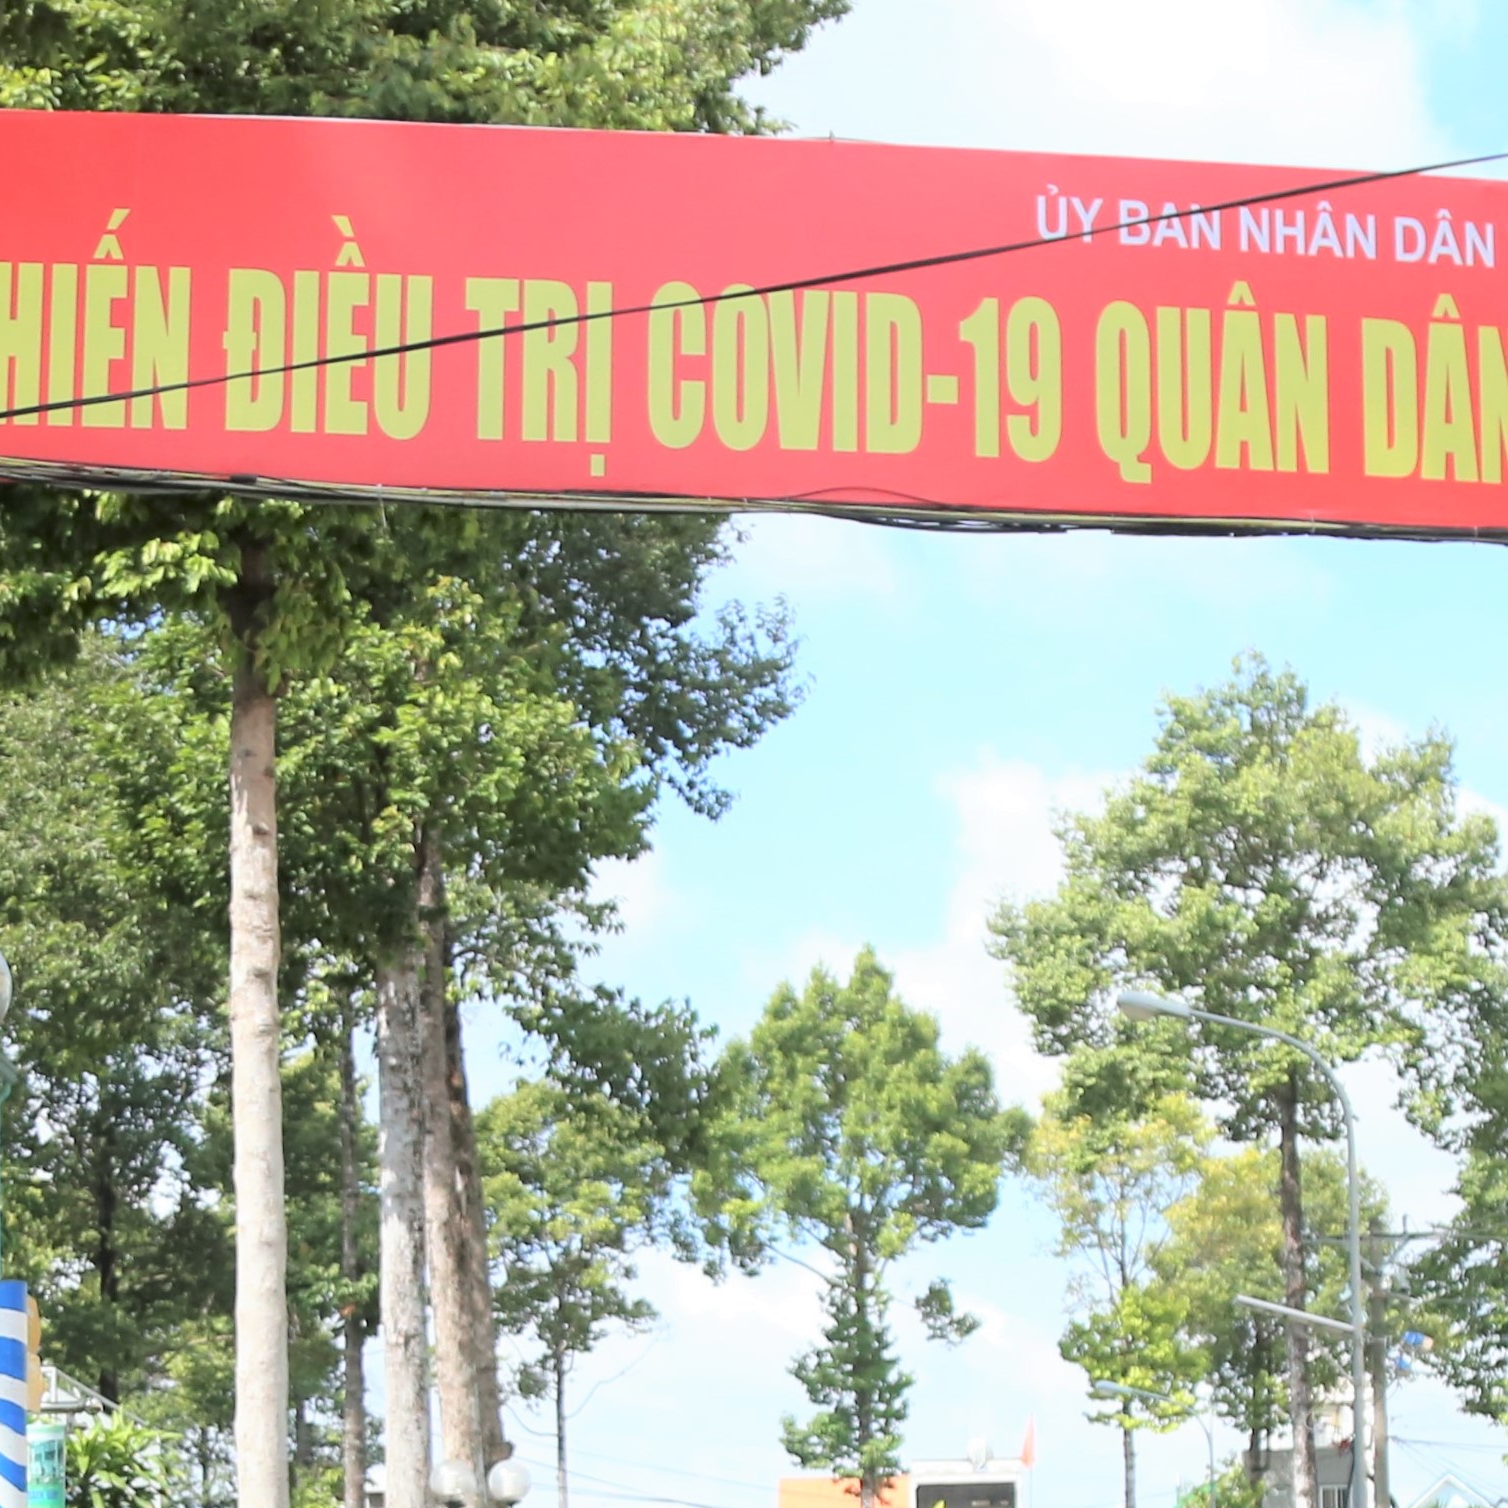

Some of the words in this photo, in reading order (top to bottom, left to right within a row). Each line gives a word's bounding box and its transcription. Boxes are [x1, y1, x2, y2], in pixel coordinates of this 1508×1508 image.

[1036, 184, 1103, 243] ỦY
[1119, 200, 1221, 249] BAN
[1238, 199, 1376, 261] NHÂN
[1395, 209, 1494, 268] DÂN
[222, 213, 436, 442] ĐIỀU
[465, 276, 613, 477] TRỊ
[647, 282, 1063, 463] COVID-19
[1096, 280, 1329, 483] QUÂN
